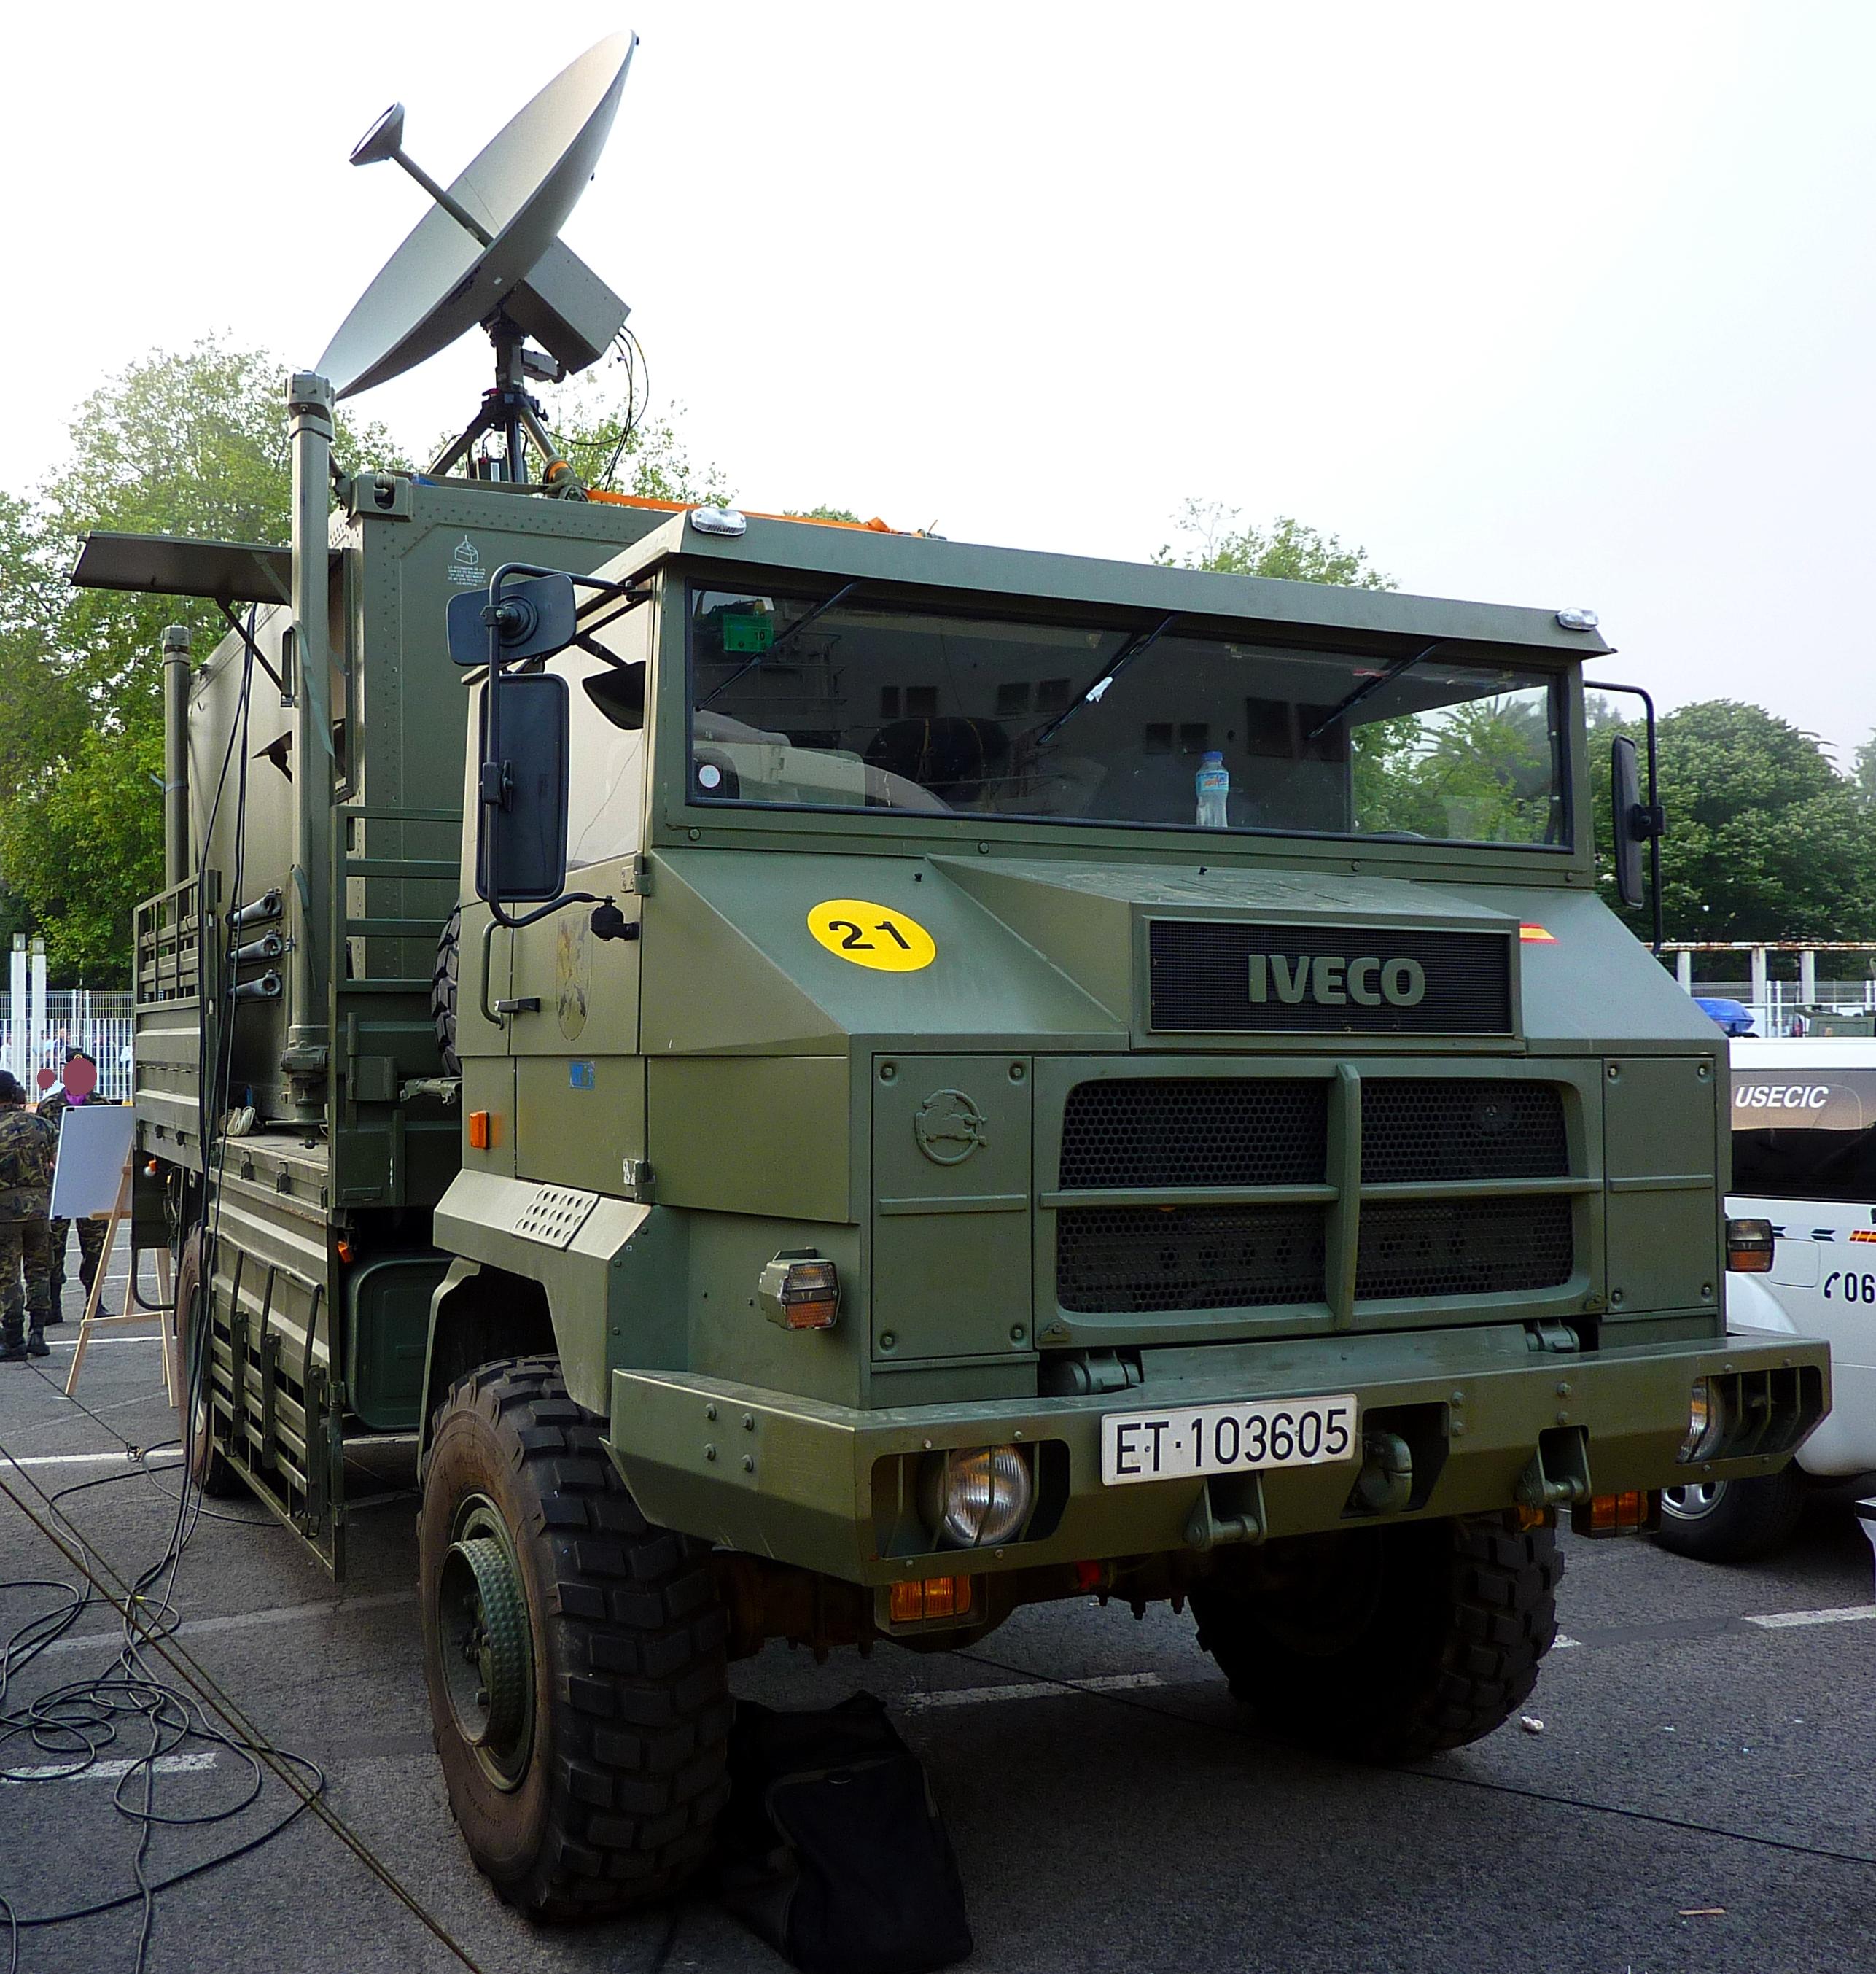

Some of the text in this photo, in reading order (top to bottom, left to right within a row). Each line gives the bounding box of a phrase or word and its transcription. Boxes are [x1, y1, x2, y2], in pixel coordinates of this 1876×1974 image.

[828, 920, 911, 949] 21
[1248, 954, 1425, 1006] IVECO
[1735, 1085, 1829, 1108] USECIC
